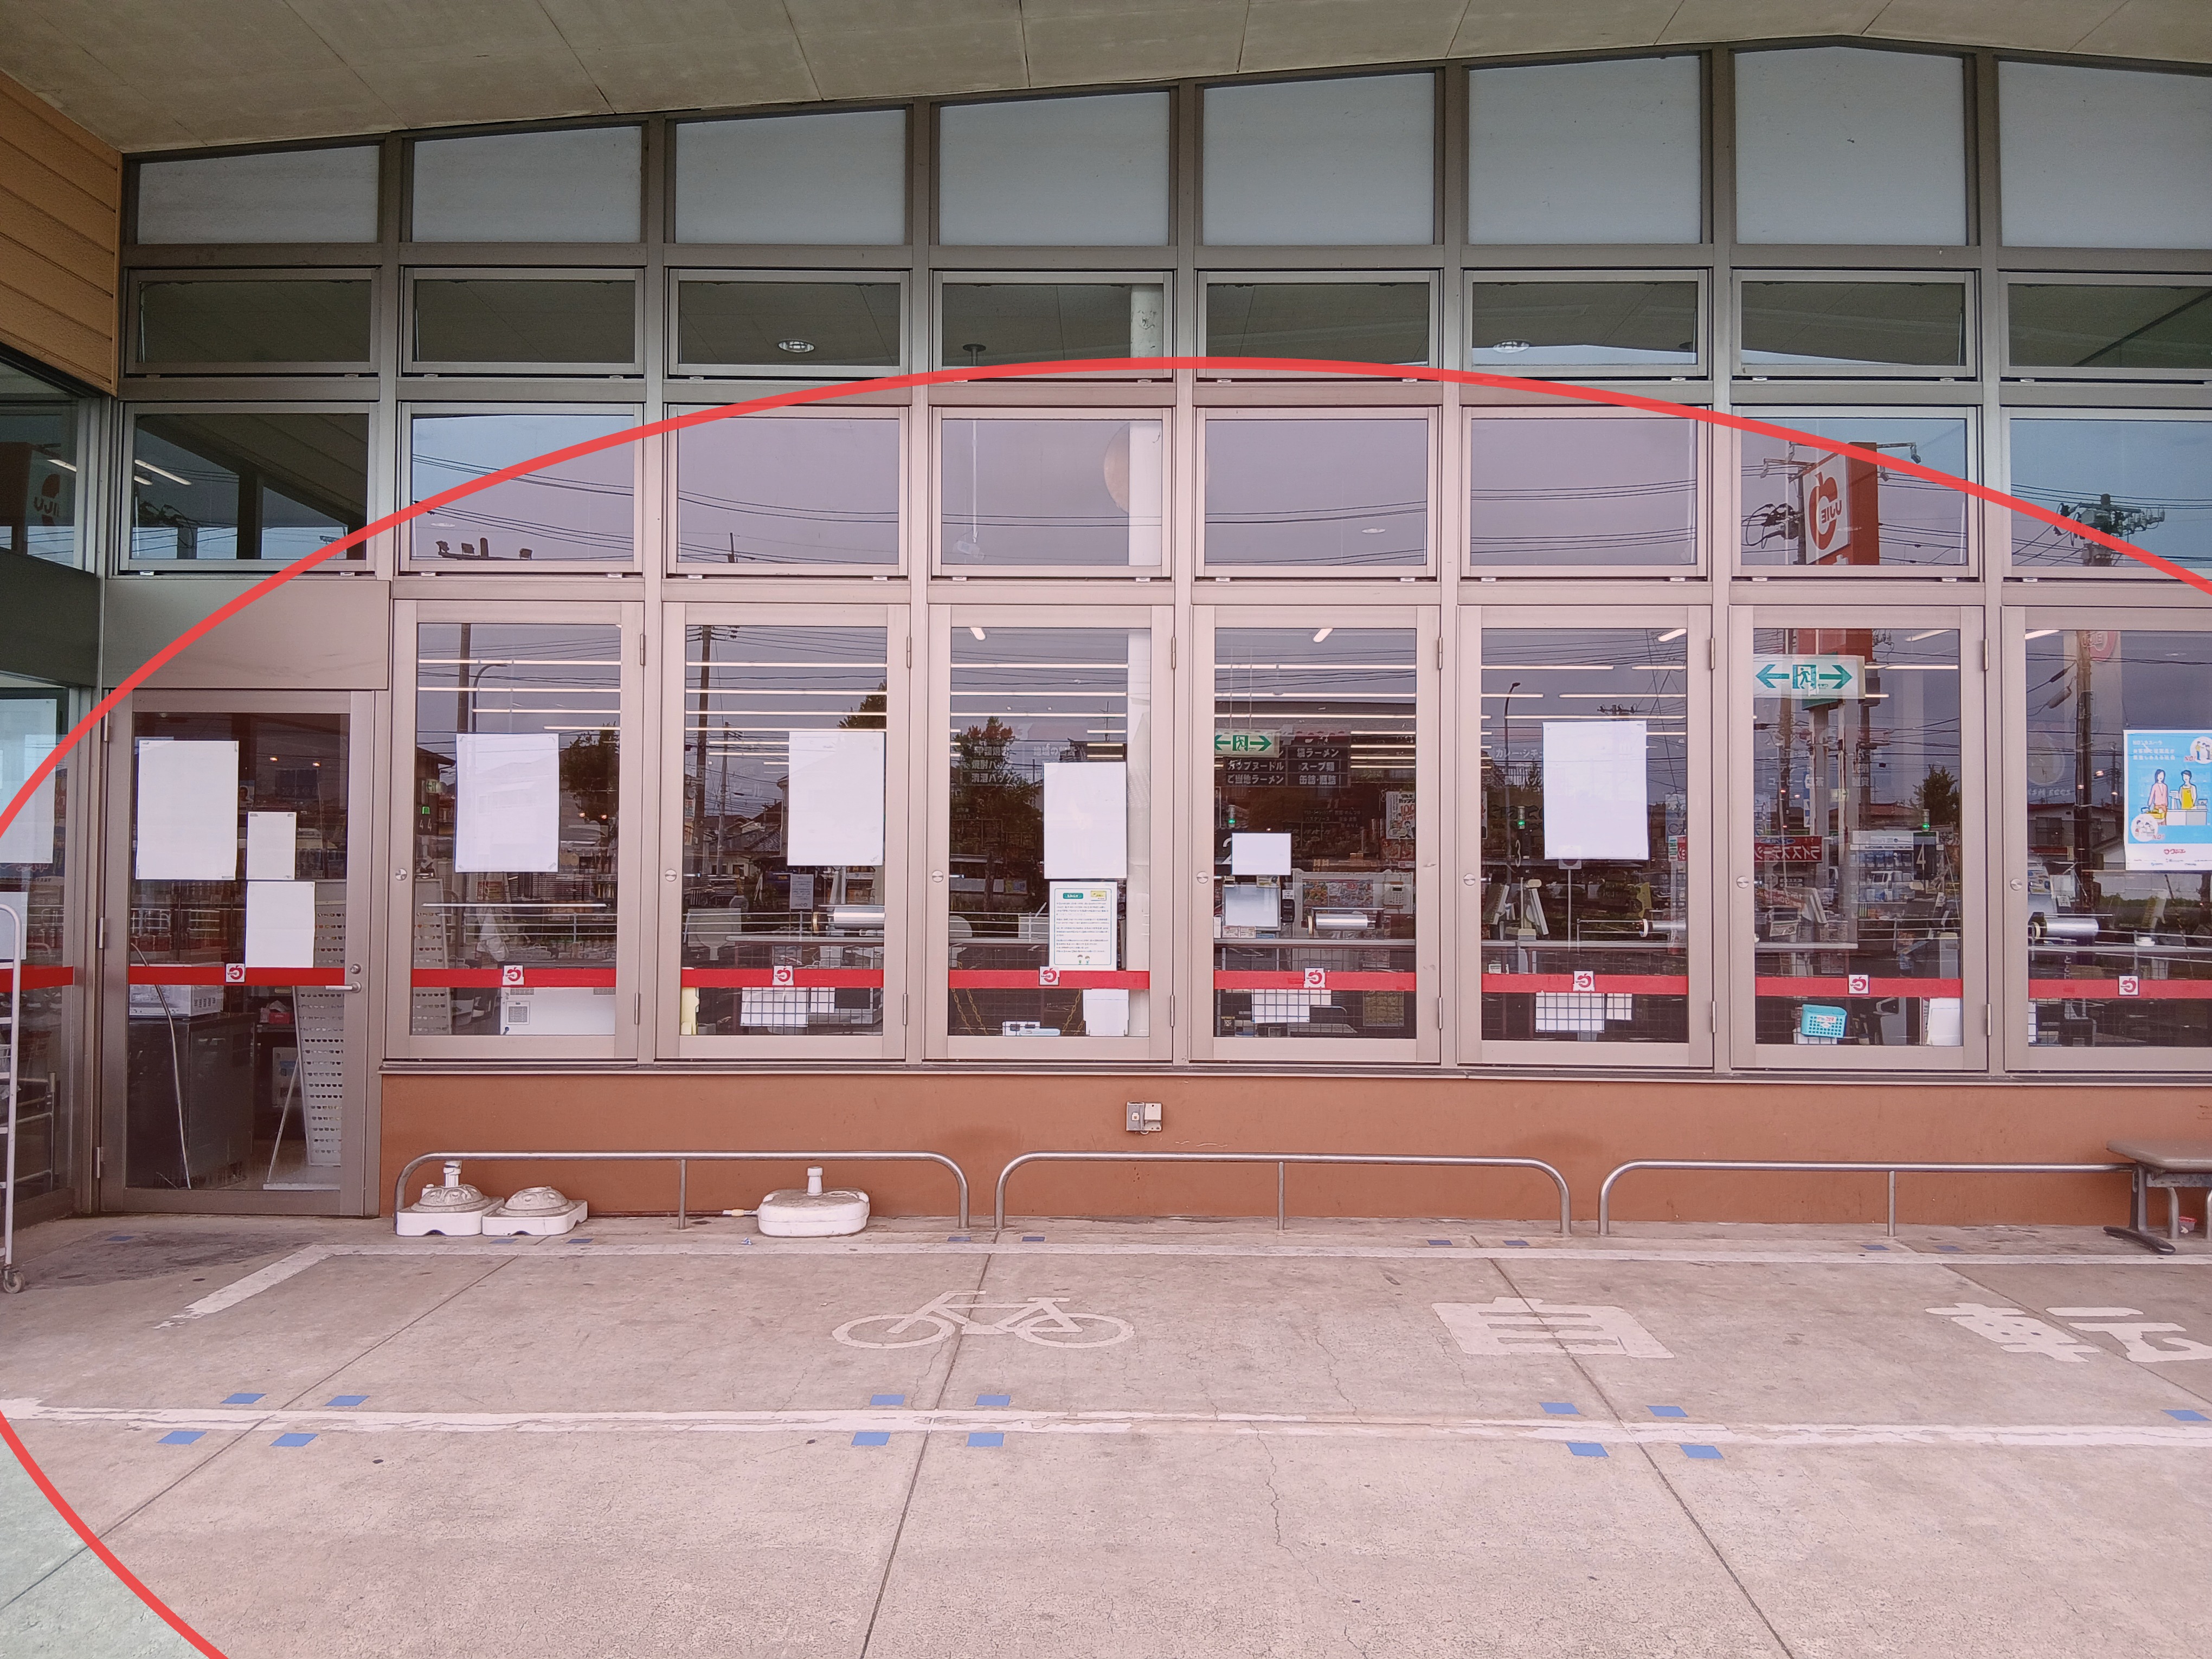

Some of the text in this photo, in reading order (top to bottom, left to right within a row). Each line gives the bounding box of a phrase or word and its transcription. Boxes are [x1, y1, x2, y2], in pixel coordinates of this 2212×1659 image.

[1227, 774, 1284, 785] ご当地ラーメン
